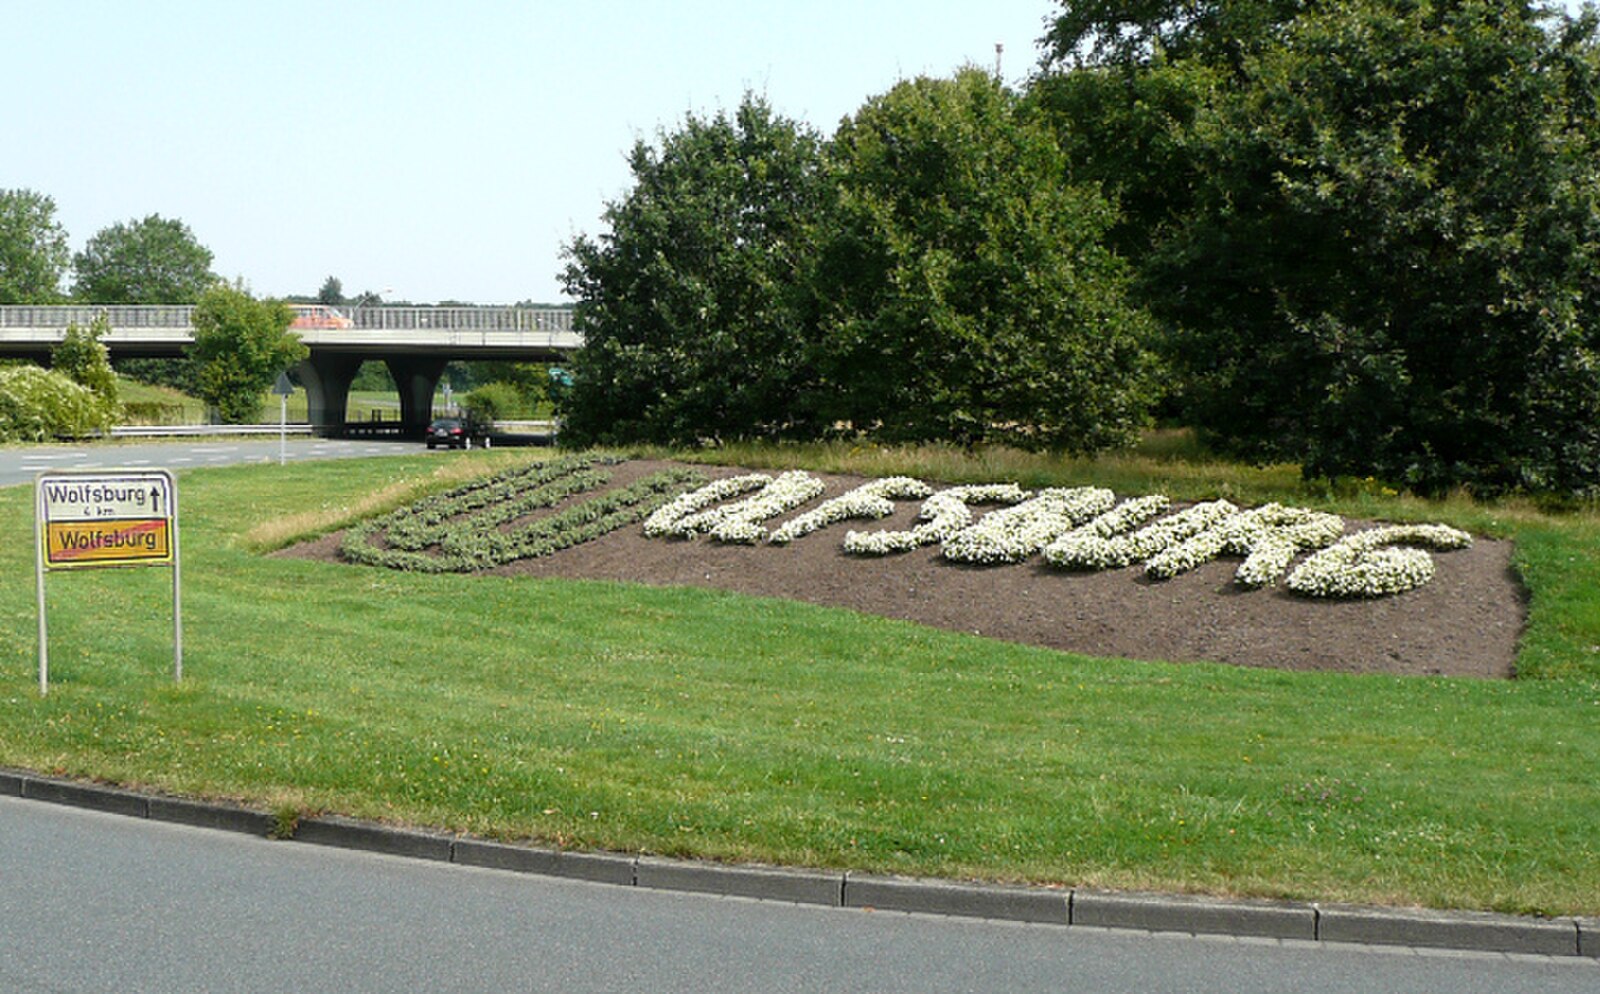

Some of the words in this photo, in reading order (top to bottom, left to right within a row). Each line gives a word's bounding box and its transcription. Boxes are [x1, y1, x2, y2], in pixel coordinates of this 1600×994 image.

[48, 485, 145, 505] Wolfsburg
[96, 506, 115, 515] km
[60, 530, 156, 549] Wolfsburg
